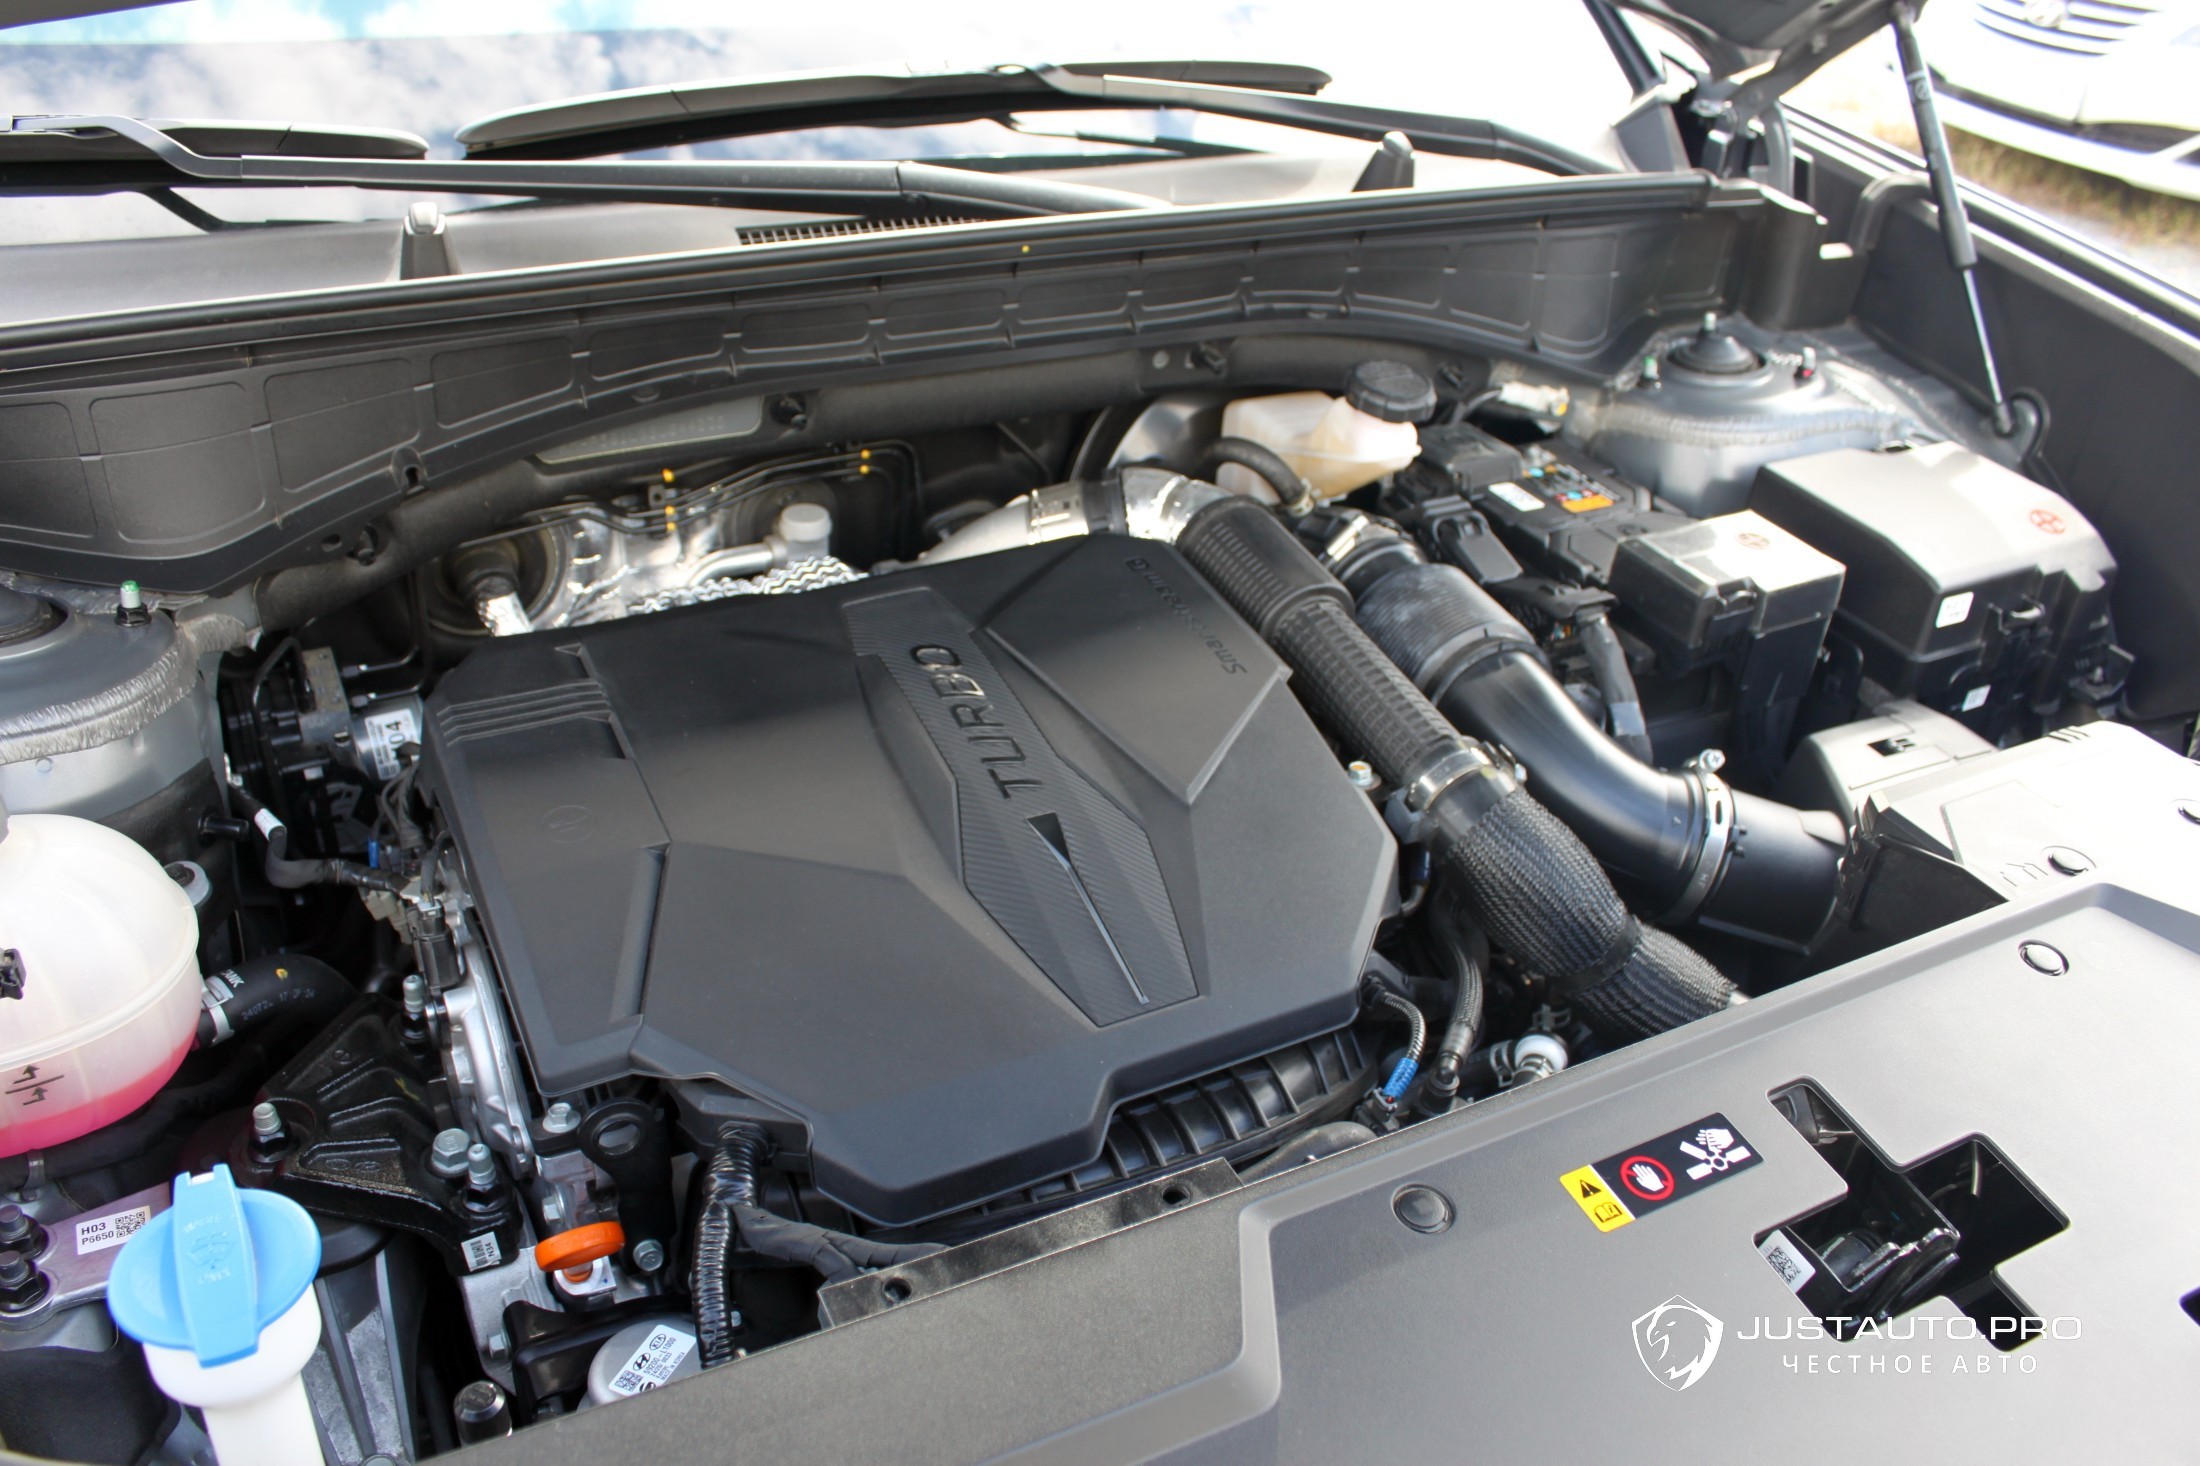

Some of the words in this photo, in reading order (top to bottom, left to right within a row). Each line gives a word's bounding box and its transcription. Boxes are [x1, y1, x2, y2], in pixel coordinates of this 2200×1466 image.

[910, 644, 1043, 799] TURBO
[81, 1222, 107, 1236] H03
[81, 1230, 115, 1246] P6650
[484, 1242, 495, 1258] N34
[650, 1334, 666, 1349] KIA
